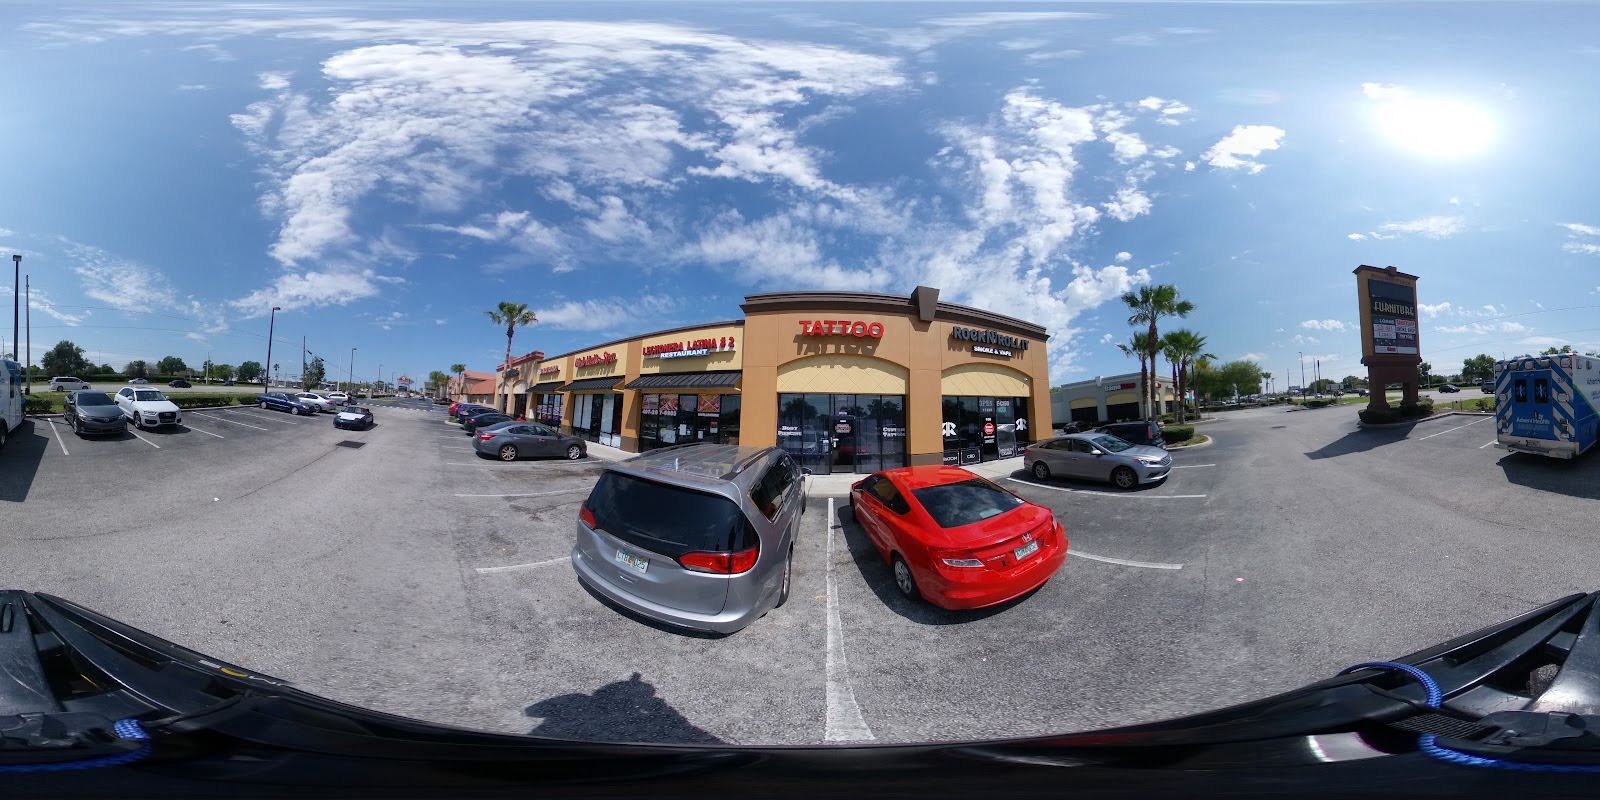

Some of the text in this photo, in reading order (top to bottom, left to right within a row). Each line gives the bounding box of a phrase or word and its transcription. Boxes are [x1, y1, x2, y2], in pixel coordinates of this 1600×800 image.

[1374, 301, 1414, 316] FURNITURE
[799, 320, 884, 338] TATTOO
[687, 338, 717, 350] LATINA
[729, 336, 735, 348] 2
[974, 346, 994, 354] SMOKE
[660, 348, 708, 358] RESTAURANT
